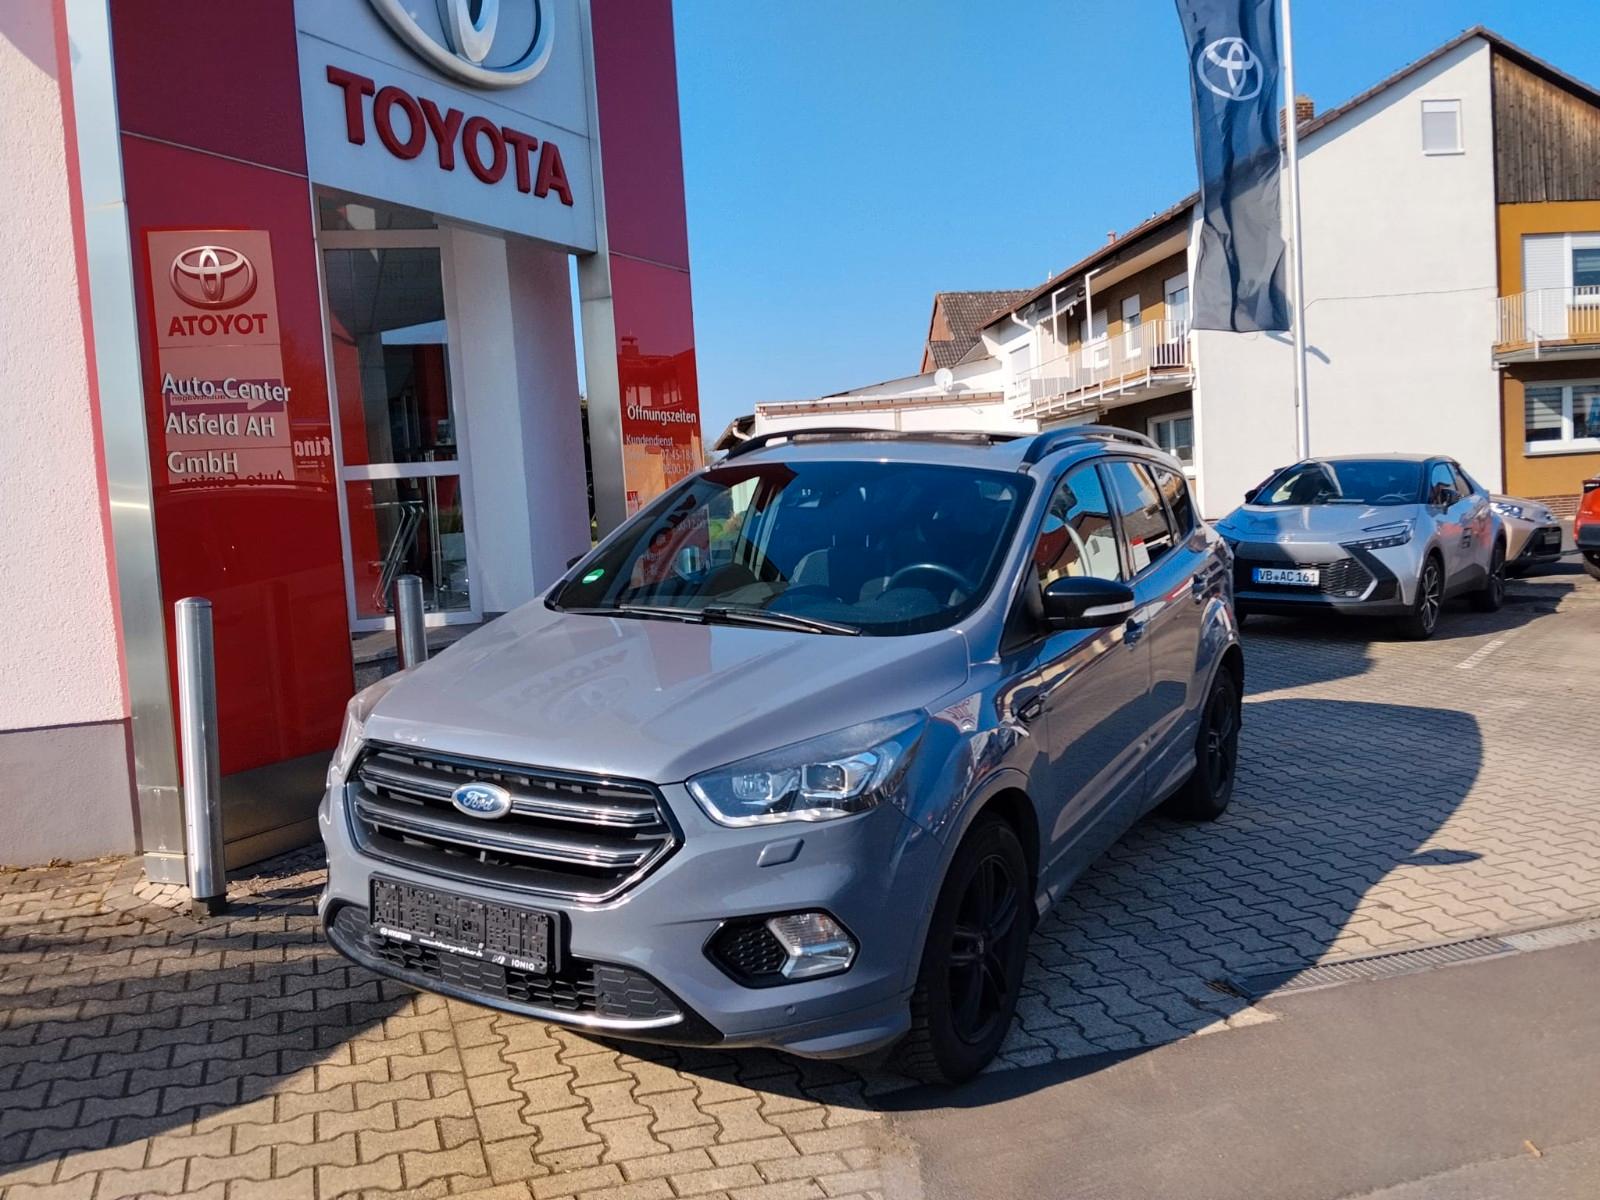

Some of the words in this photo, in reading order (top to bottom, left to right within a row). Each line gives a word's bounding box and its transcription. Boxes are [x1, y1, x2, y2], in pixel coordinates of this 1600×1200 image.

[326, 64, 574, 208] TOYOTA
[161, 373, 292, 402] Auto-Center
[165, 411, 239, 436] Alsfeld
[245, 415, 276, 437] AH
[627, 403, 697, 425] Öffnungszeiten
[625, 433, 674, 447] Kundendienst
[167, 450, 239, 474] GmbH
[1259, 570, 1273, 581] VB
[463, 790, 495, 811] Ford
